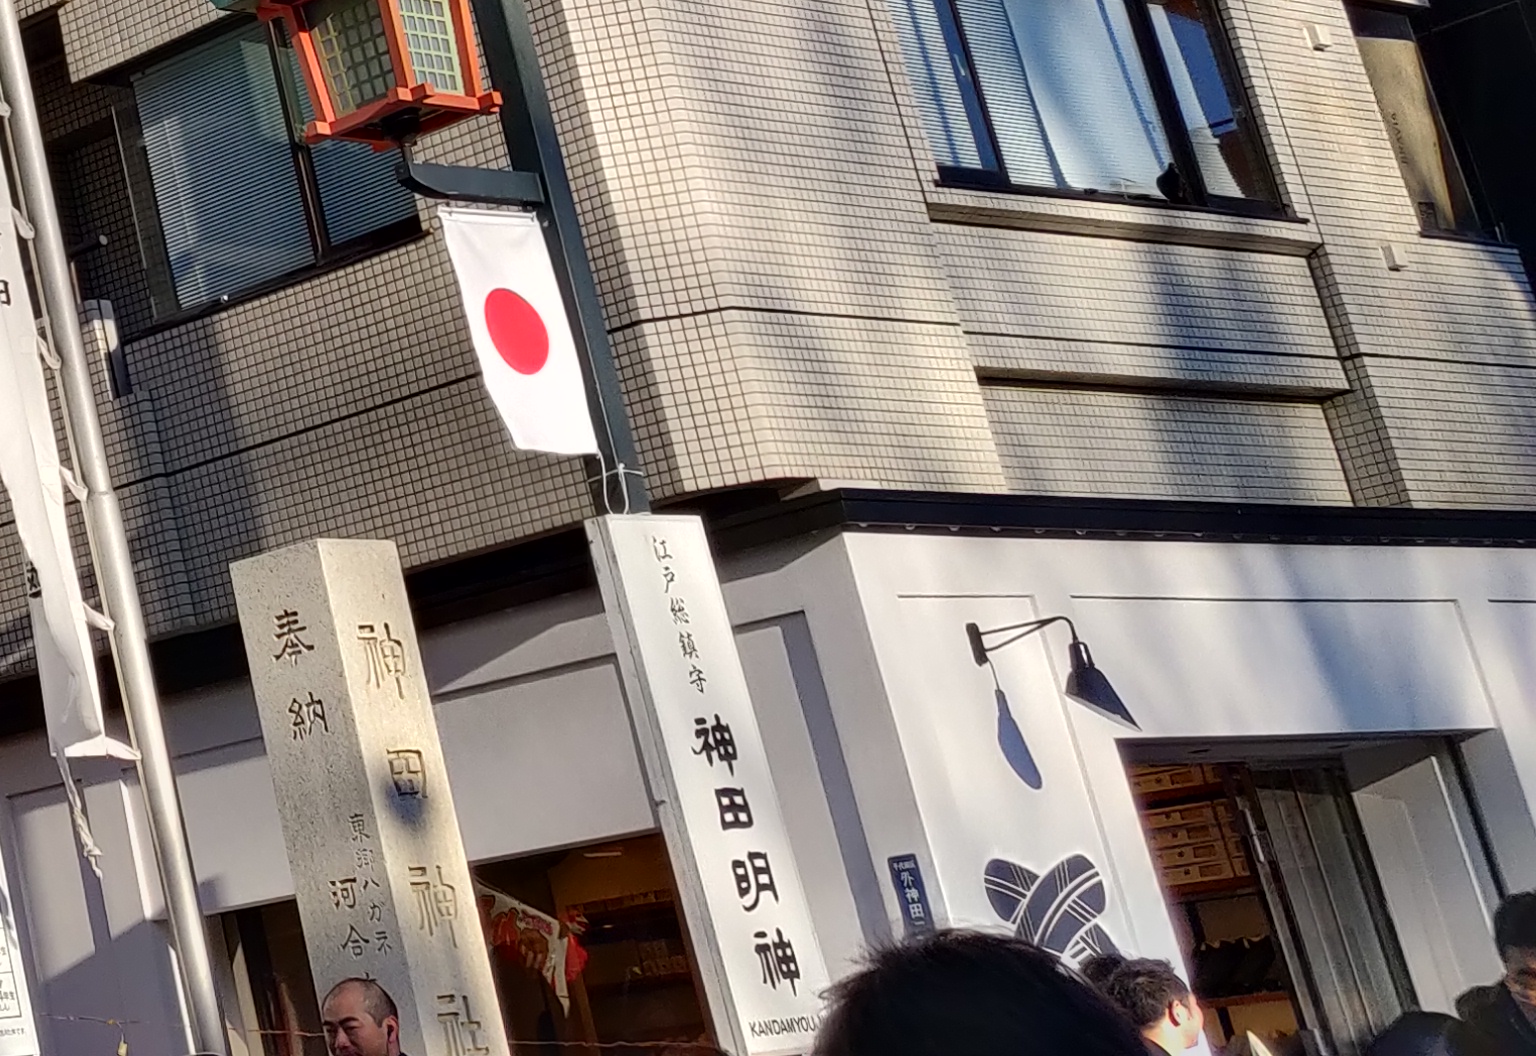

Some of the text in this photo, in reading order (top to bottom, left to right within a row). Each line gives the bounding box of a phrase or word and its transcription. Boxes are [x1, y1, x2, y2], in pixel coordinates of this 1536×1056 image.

[271, 608, 329, 743] 奉納
[651, 535, 707, 694] 江戸総鎮守
[357, 622, 490, 1056] 神田神社
[691, 713, 800, 998] 神田明神
[329, 876, 378, 982] 河合
